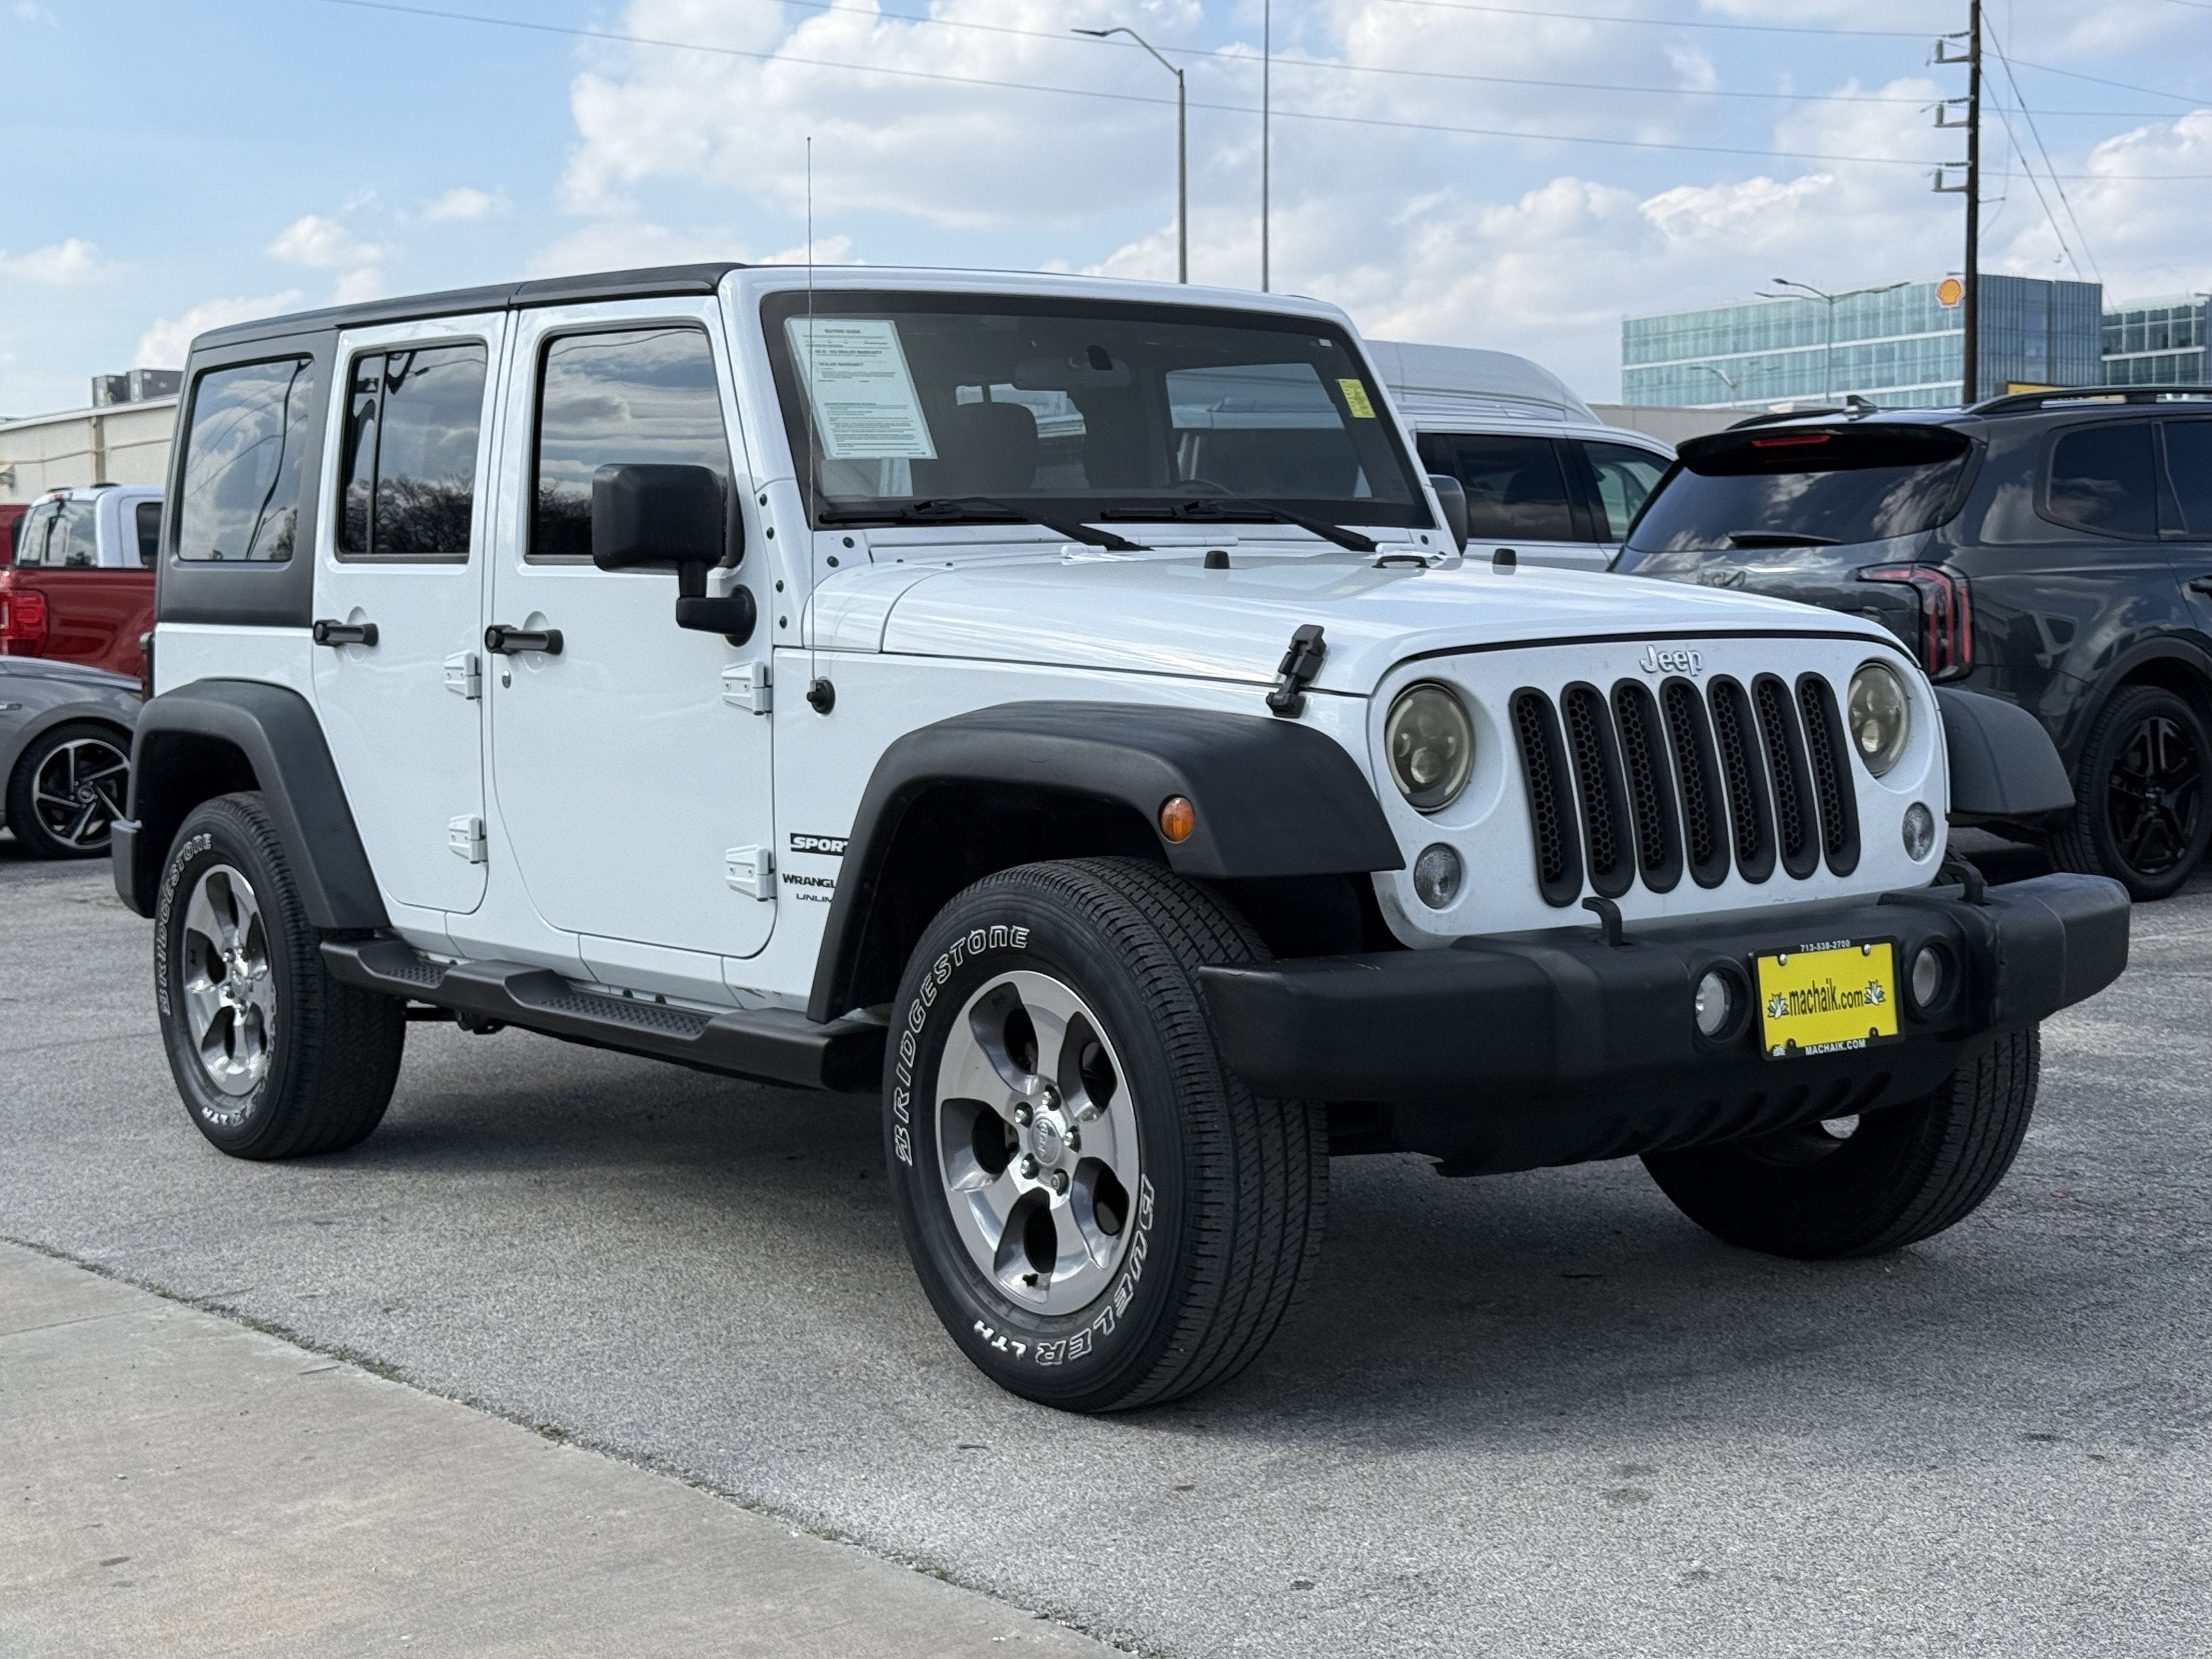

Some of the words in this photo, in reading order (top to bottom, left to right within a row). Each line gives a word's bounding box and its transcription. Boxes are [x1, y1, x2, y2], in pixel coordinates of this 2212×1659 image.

[1639, 644, 1702, 678] Jeep
[1800, 939, 1851, 952] 713-538-2700
[1789, 978, 1864, 1016] machaik.com
[893, 925, 1030, 1167] BRIDGESTONE
[1805, 1039, 1866, 1056] MACHAIK.COM
[1035, 1173, 1155, 1366] DUELER
